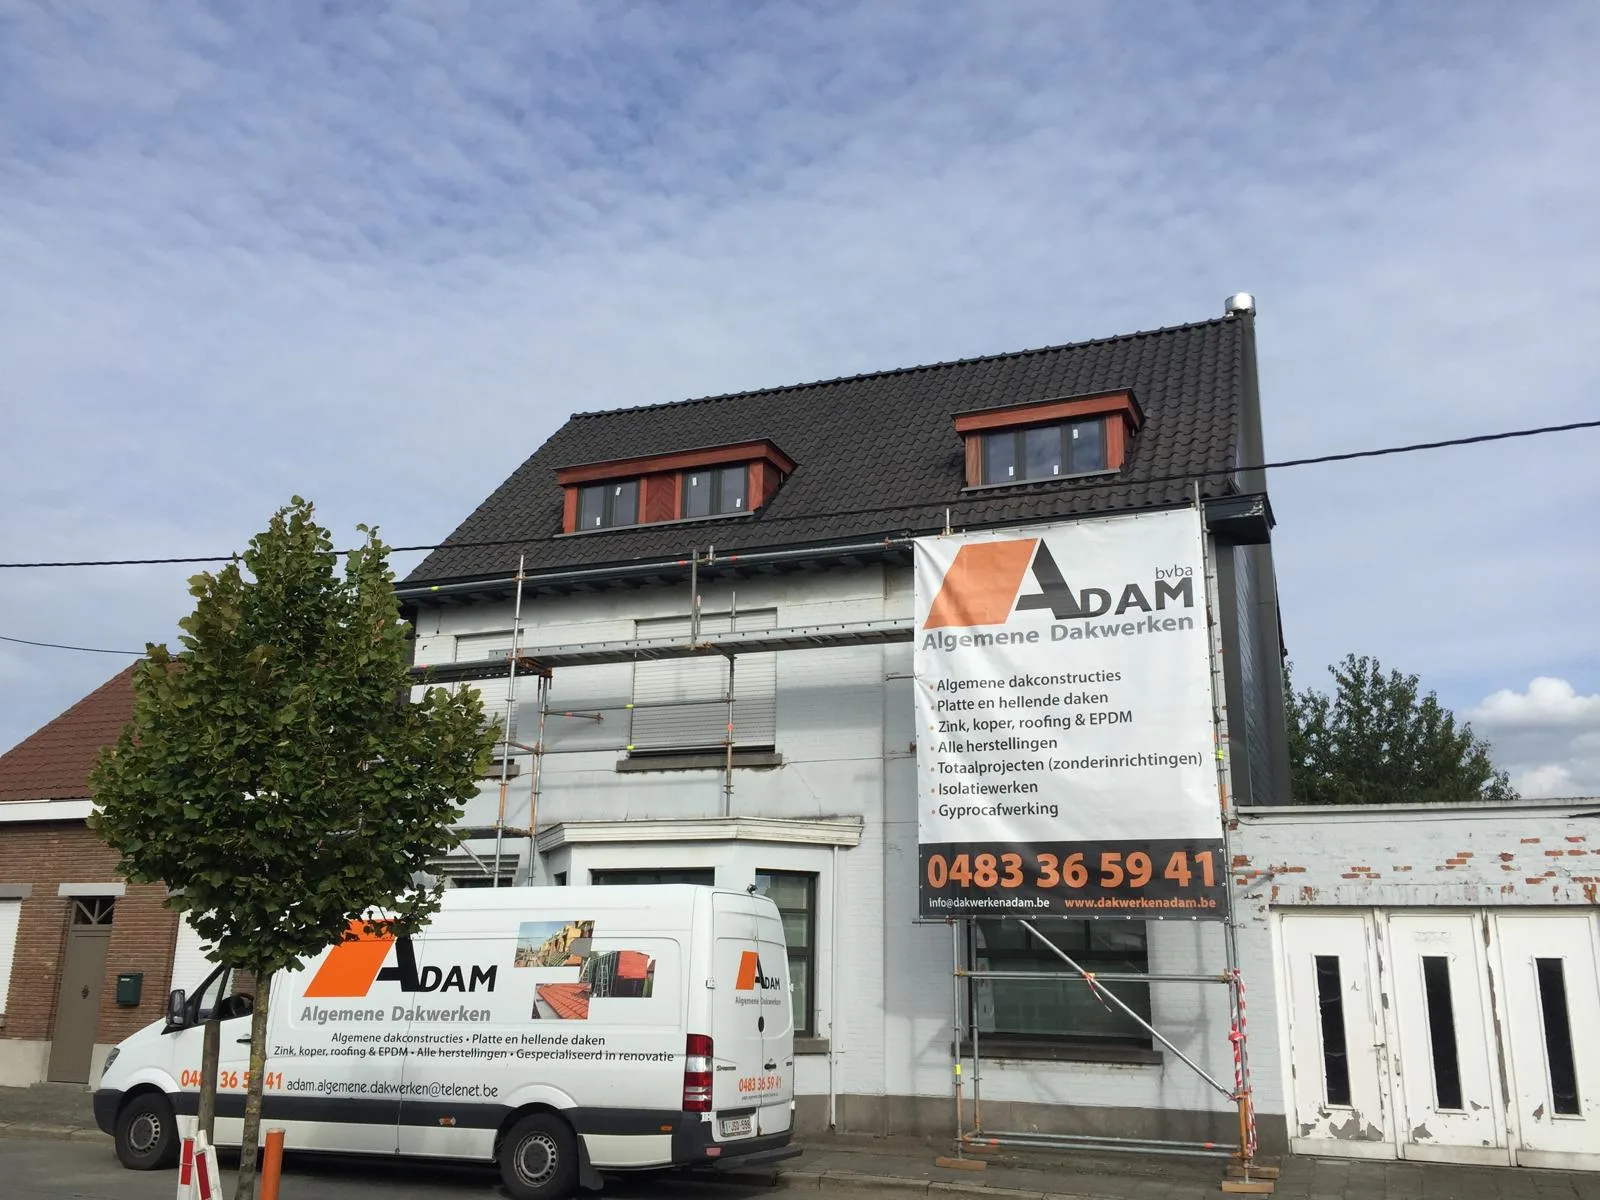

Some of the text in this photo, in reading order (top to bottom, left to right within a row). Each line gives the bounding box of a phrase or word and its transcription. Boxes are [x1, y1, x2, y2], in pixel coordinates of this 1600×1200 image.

[1015, 538, 1194, 620] ADAM
[1155, 565, 1193, 579] bvba
[922, 614, 1194, 652] Algemene Dakwerken
[937, 670, 1122, 693] Algemene dakconstructies
[937, 692, 1108, 712] Platte en hellende daken
[938, 710, 1132, 734] Zink, koper, roofing & EPDM
[938, 737, 1058, 753] Alle herstellingen
[938, 751, 1202, 776] Totaalprojecten (zonderinrichtingen)
[938, 780, 1038, 796] Isolatiewerken
[939, 801, 1058, 819] Gyprocafwerking
[928, 851, 1216, 888] 0483 36 59 41
[929, 897, 1216, 908] info@dakwerkenadam.be www.dakwerkenadam.be
[376, 934, 498, 992] ADAM
[755, 953, 780, 990] ADAM
[300, 1005, 490, 1025] Algemene Dakwerken
[331, 1033, 605, 1046] Algemene dakconstructies Platte en hellende daken
[274, 1046, 674, 1062] Zink, koper, roofing & EPDM Alle herstellingen Gespecialiseerd in renovatie
[220, 1071, 238, 1088] 36
[266, 1072, 282, 1090] 41
[287, 1079, 498, 1098] adam.algemene.dakwerken@telenet.be
[739, 1078, 756, 1092] 0483
[758, 1077, 765, 1090] 36
[767, 1076, 774, 1090] 59
